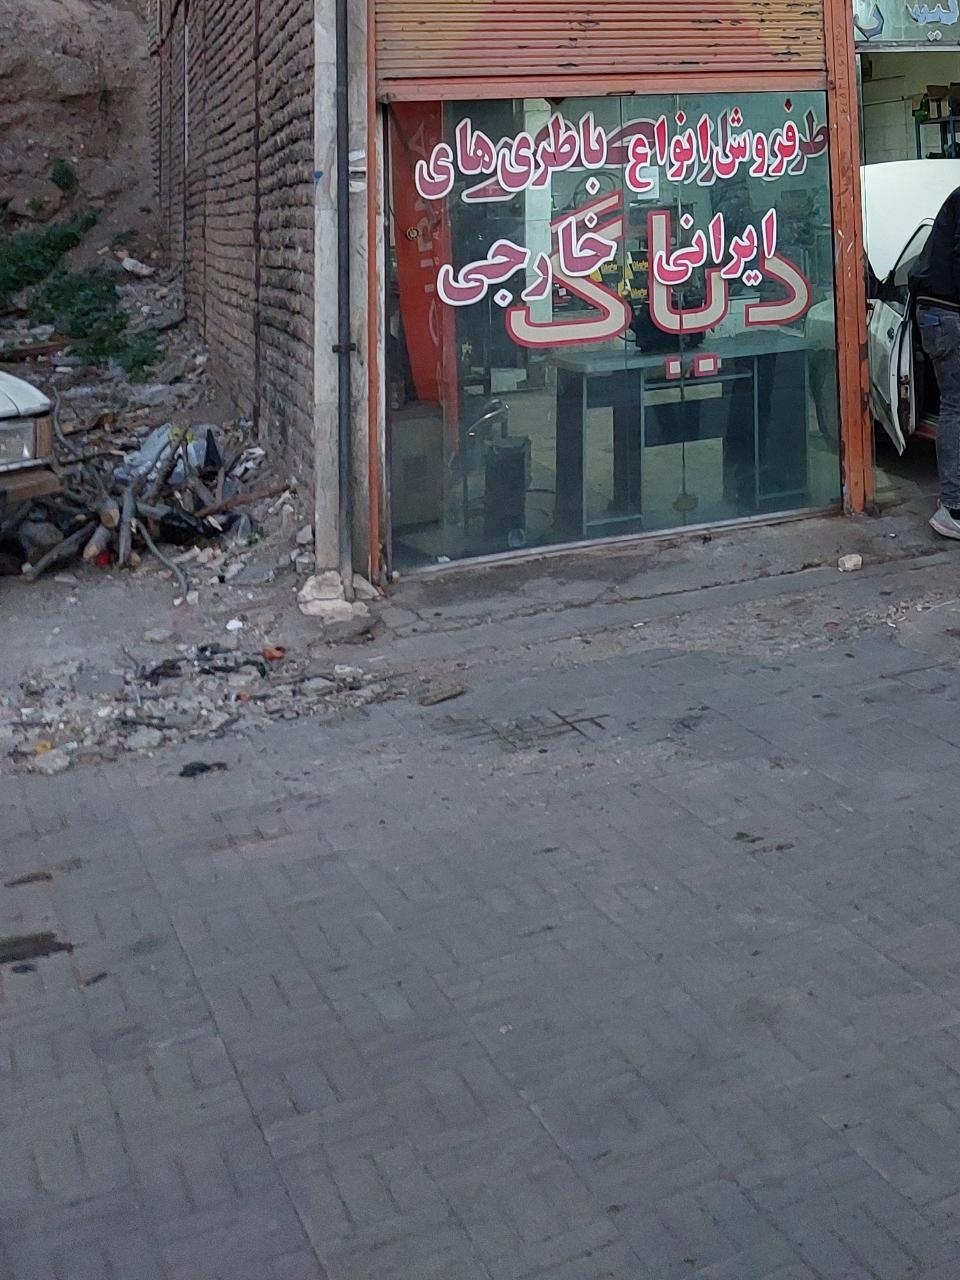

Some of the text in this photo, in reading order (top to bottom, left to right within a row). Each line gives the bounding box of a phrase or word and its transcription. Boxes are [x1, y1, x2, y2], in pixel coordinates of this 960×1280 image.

[414, 117, 498, 200] های
[497, 110, 608, 196] باطری
[625, 110, 711, 193] انواع
[712, 97, 801, 179] فروش
[437, 211, 618, 308] خارجی
[654, 208, 778, 287] ایرانی
